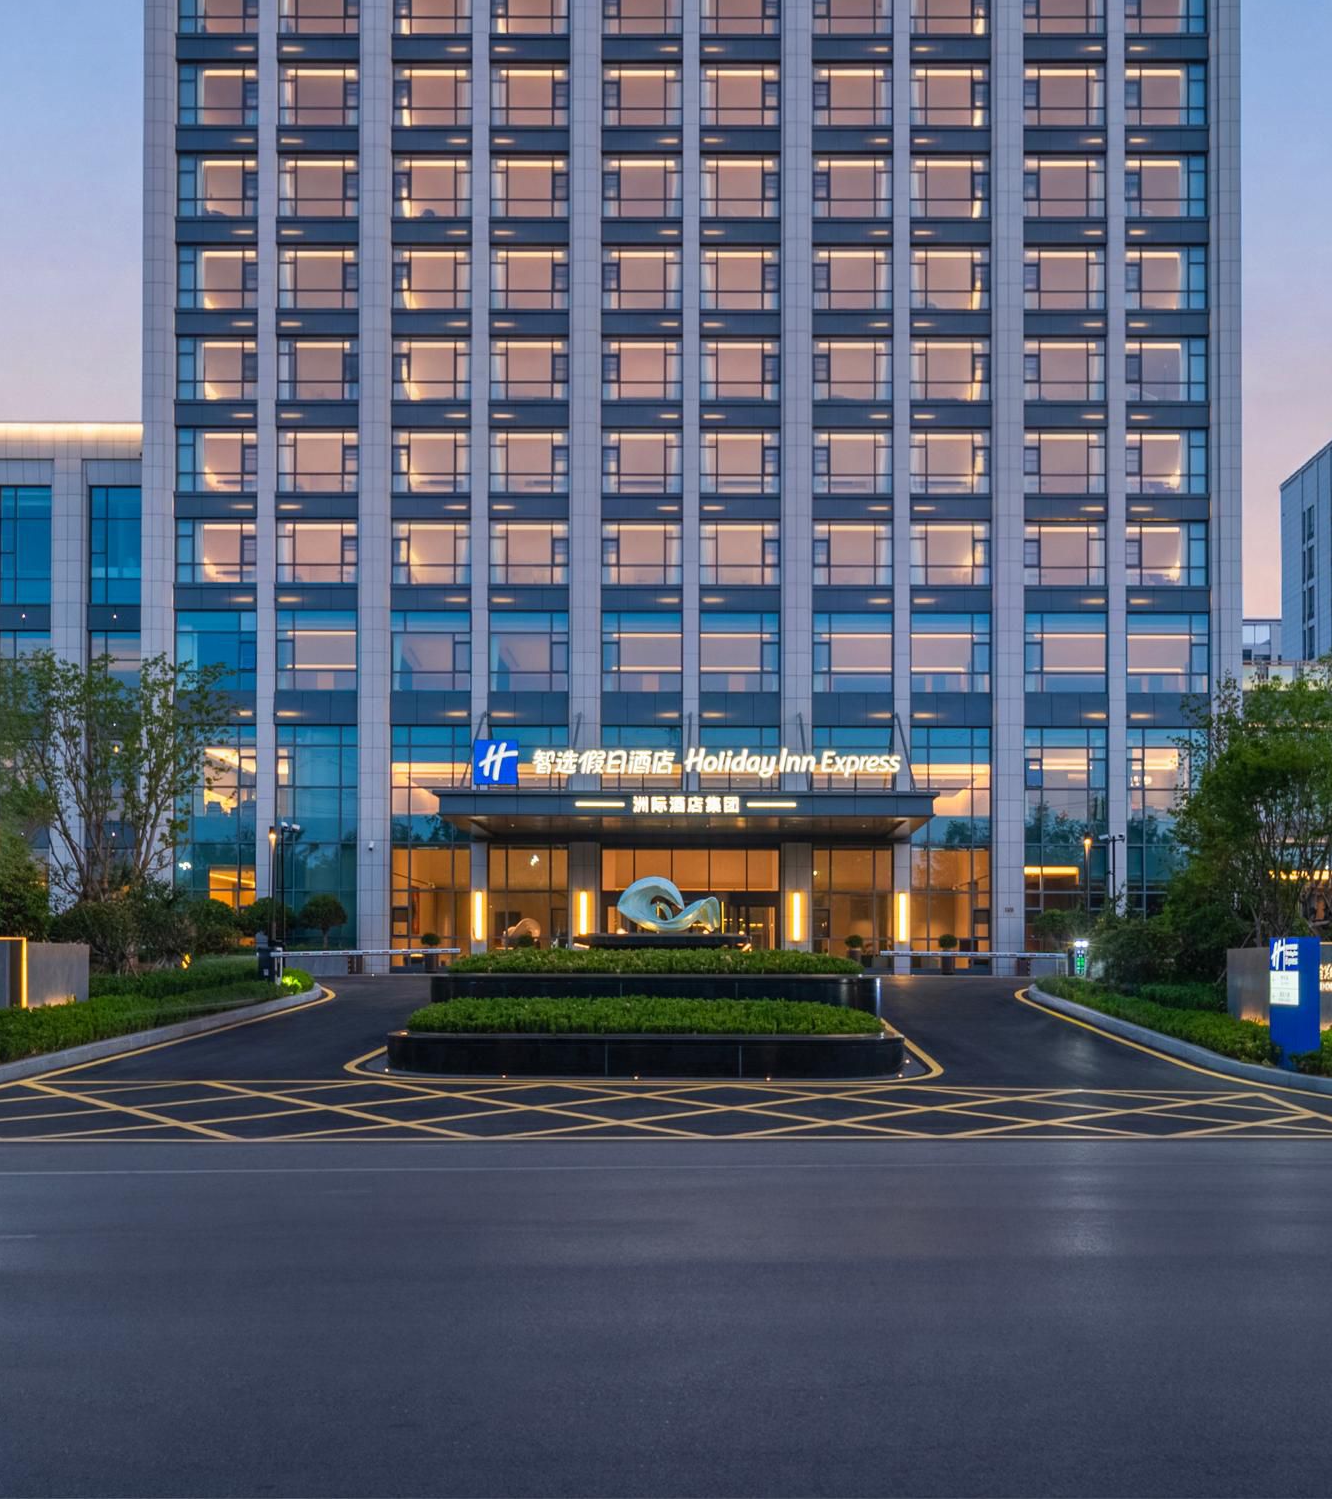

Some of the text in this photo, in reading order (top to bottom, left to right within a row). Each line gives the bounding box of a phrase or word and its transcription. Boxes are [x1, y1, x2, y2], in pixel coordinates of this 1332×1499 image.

[531, 748, 675, 776] 智选假日酒店
[683, 747, 901, 779] Holiday Inn Express
[632, 795, 740, 814] 洲际酒店集团
